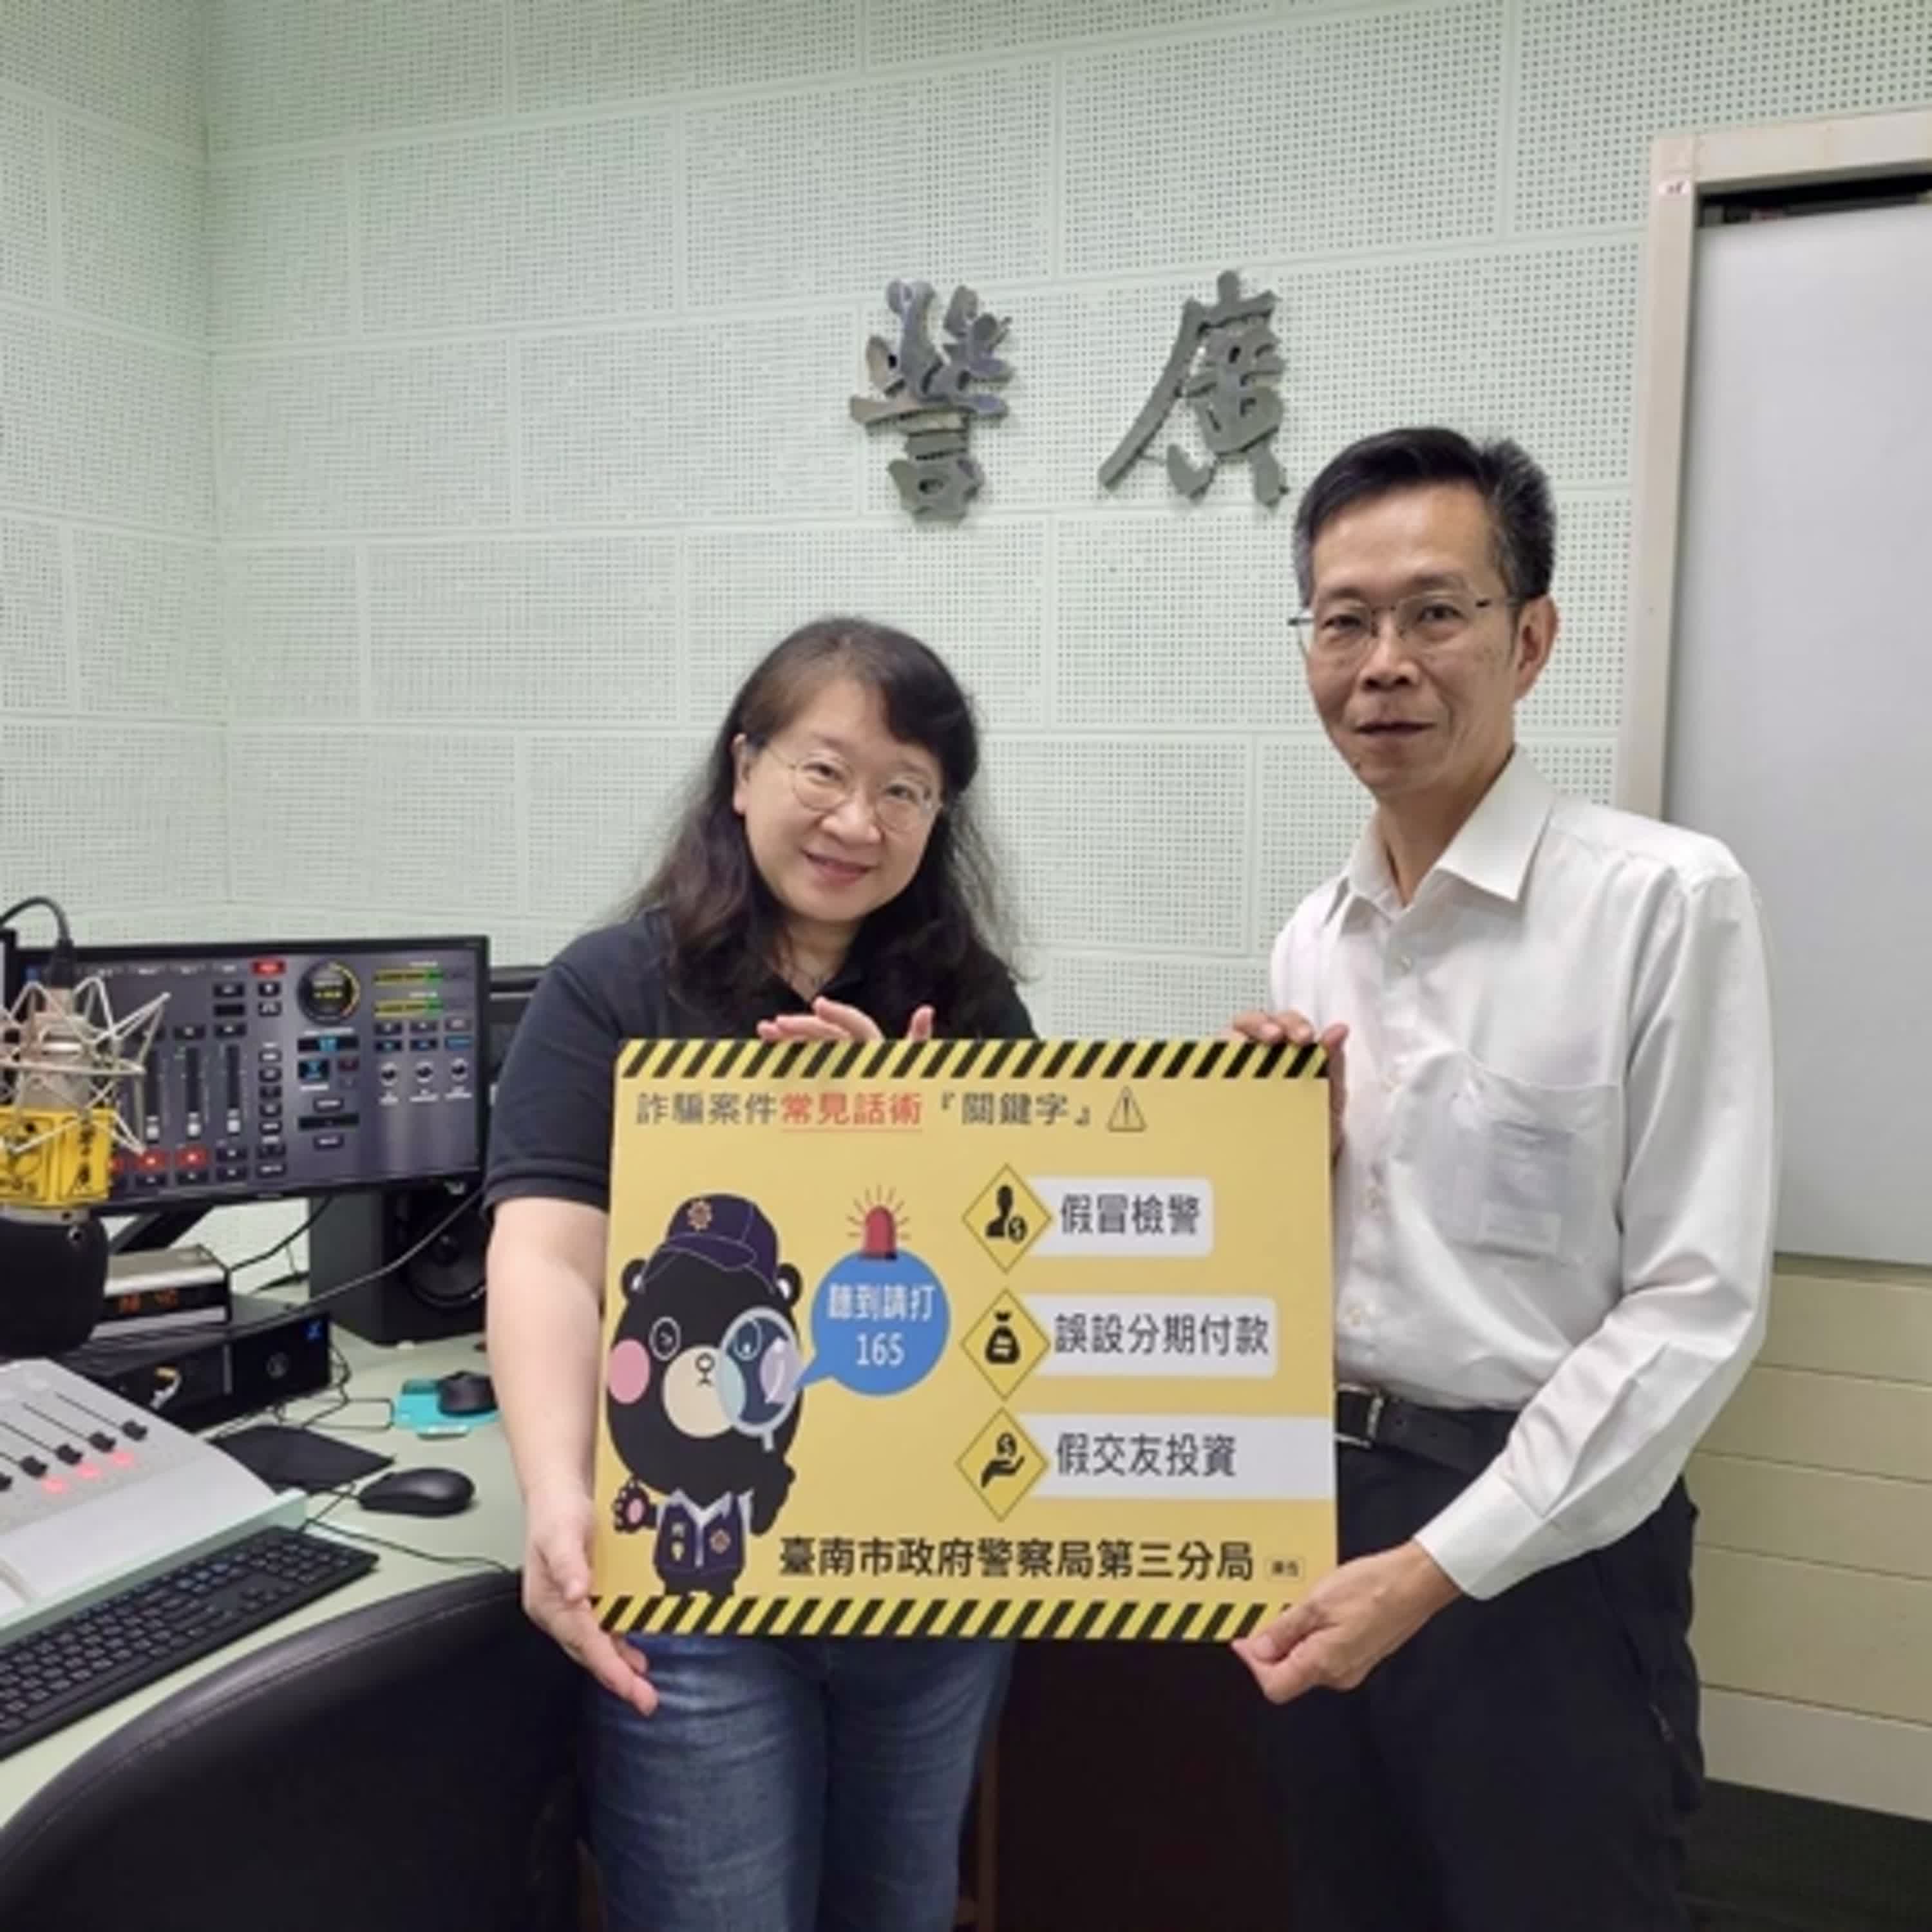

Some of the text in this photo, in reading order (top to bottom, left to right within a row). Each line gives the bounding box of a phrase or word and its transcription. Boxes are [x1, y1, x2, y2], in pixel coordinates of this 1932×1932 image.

[1061, 1193, 1199, 1235] 假冒檢警
[857, 1332, 904, 1367] 165
[1054, 1314, 1269, 1356] 誤設分期付款
[1056, 1434, 1235, 1477] 假交友投資
[779, 1537, 1253, 1580] 臺南市政府警察局第三分局
